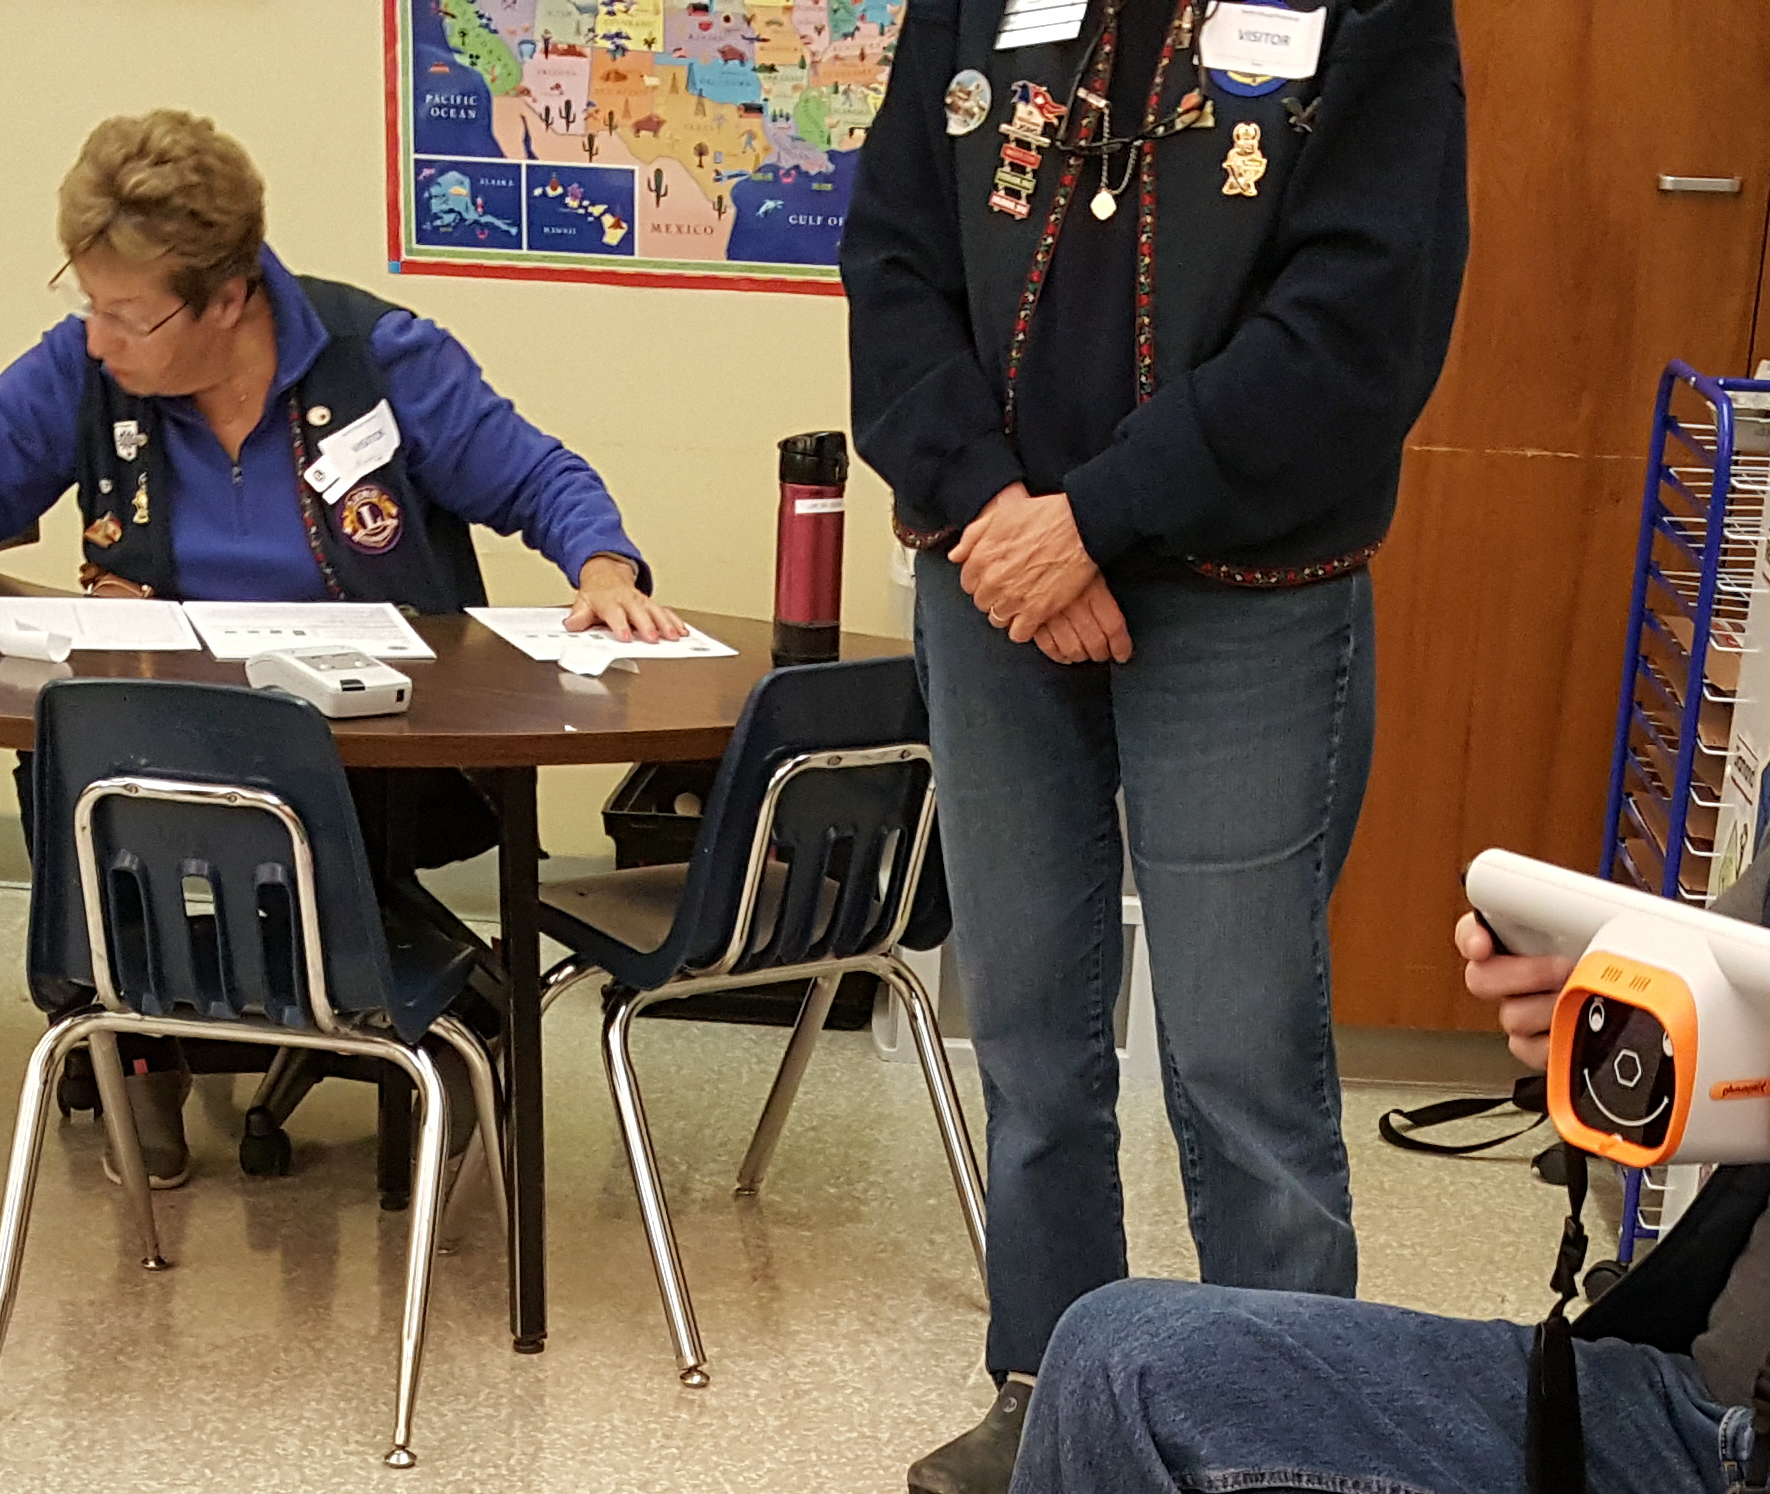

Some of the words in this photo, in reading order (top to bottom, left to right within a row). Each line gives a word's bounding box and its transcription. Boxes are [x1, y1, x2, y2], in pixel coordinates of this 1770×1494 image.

[1238, 29, 1291, 46] VISITOR
[425, 93, 478, 106] PACIFIC
[430, 106, 478, 119] OCEAN
[788, 214, 823, 226] GULF
[649, 222, 715, 236] MEXICO
